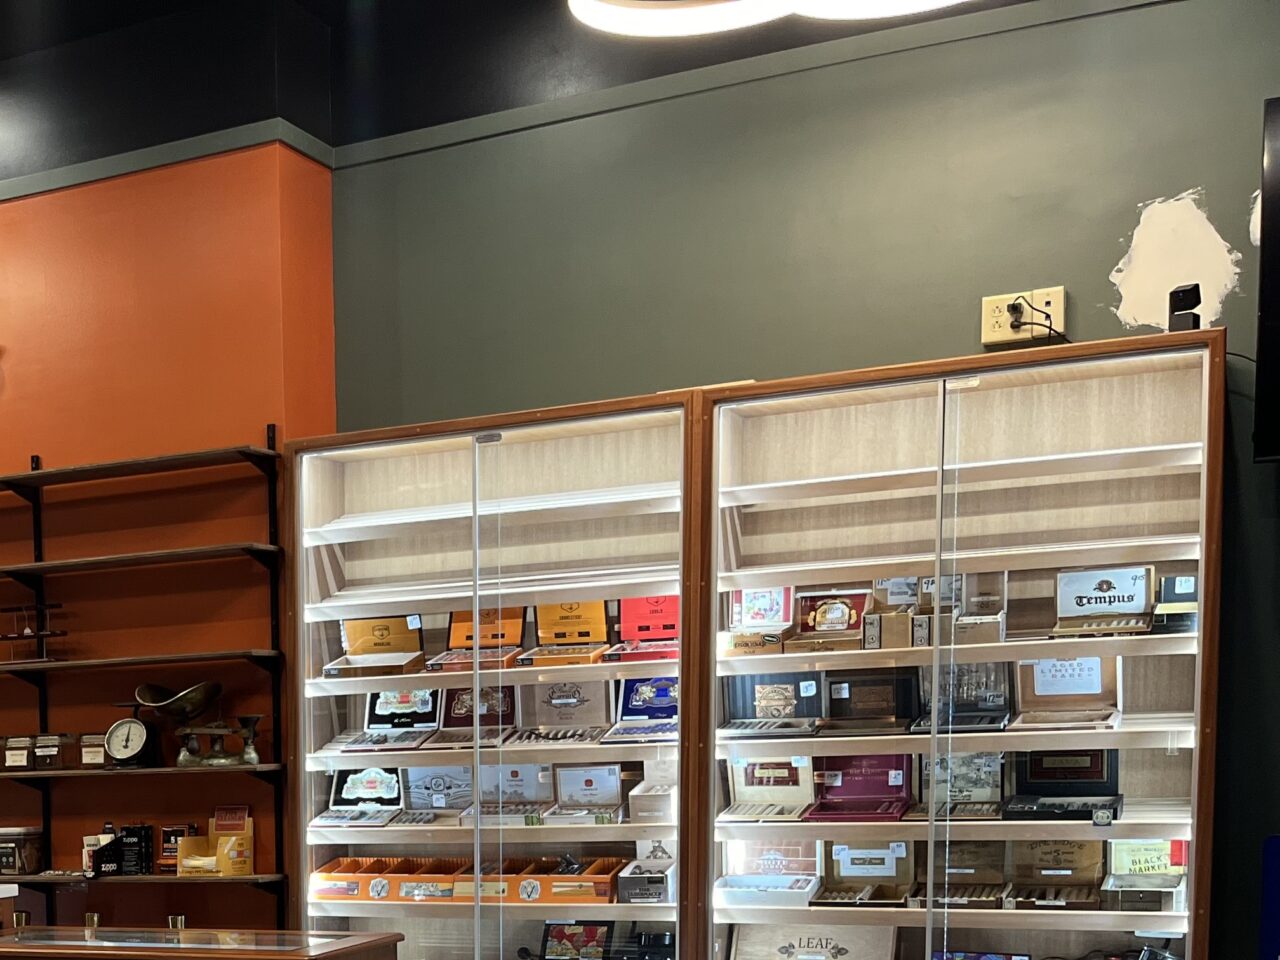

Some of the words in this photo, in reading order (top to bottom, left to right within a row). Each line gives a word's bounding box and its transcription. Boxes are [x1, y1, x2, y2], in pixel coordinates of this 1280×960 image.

[1074, 594, 1136, 607] Tempus
[1131, 856, 1162, 866] BLACK
[1129, 863, 1168, 875] MARKET
[798, 937, 834, 949] LEAF
